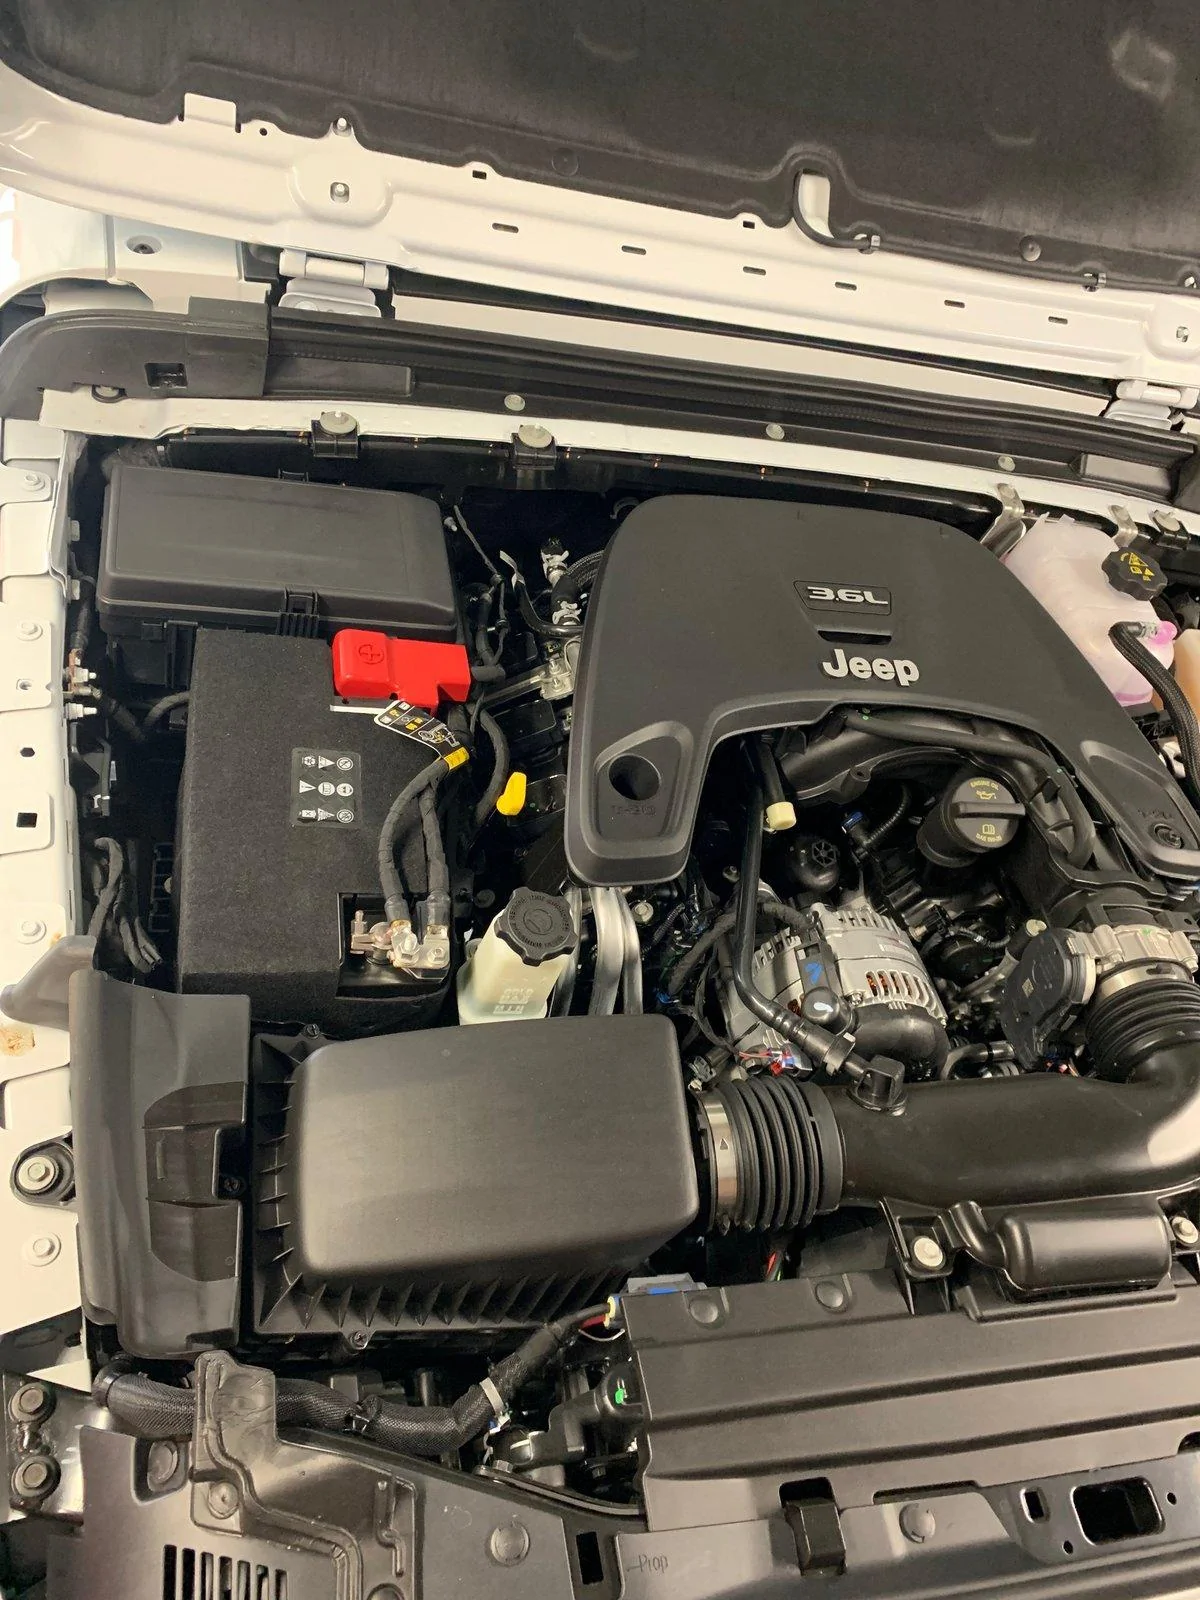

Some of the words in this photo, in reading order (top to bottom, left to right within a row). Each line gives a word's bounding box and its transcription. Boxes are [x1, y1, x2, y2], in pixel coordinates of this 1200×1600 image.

[807, 586, 889, 605] 3.6L
[822, 648, 920, 686] Jeep
[969, 780, 990, 788] ENGINE
